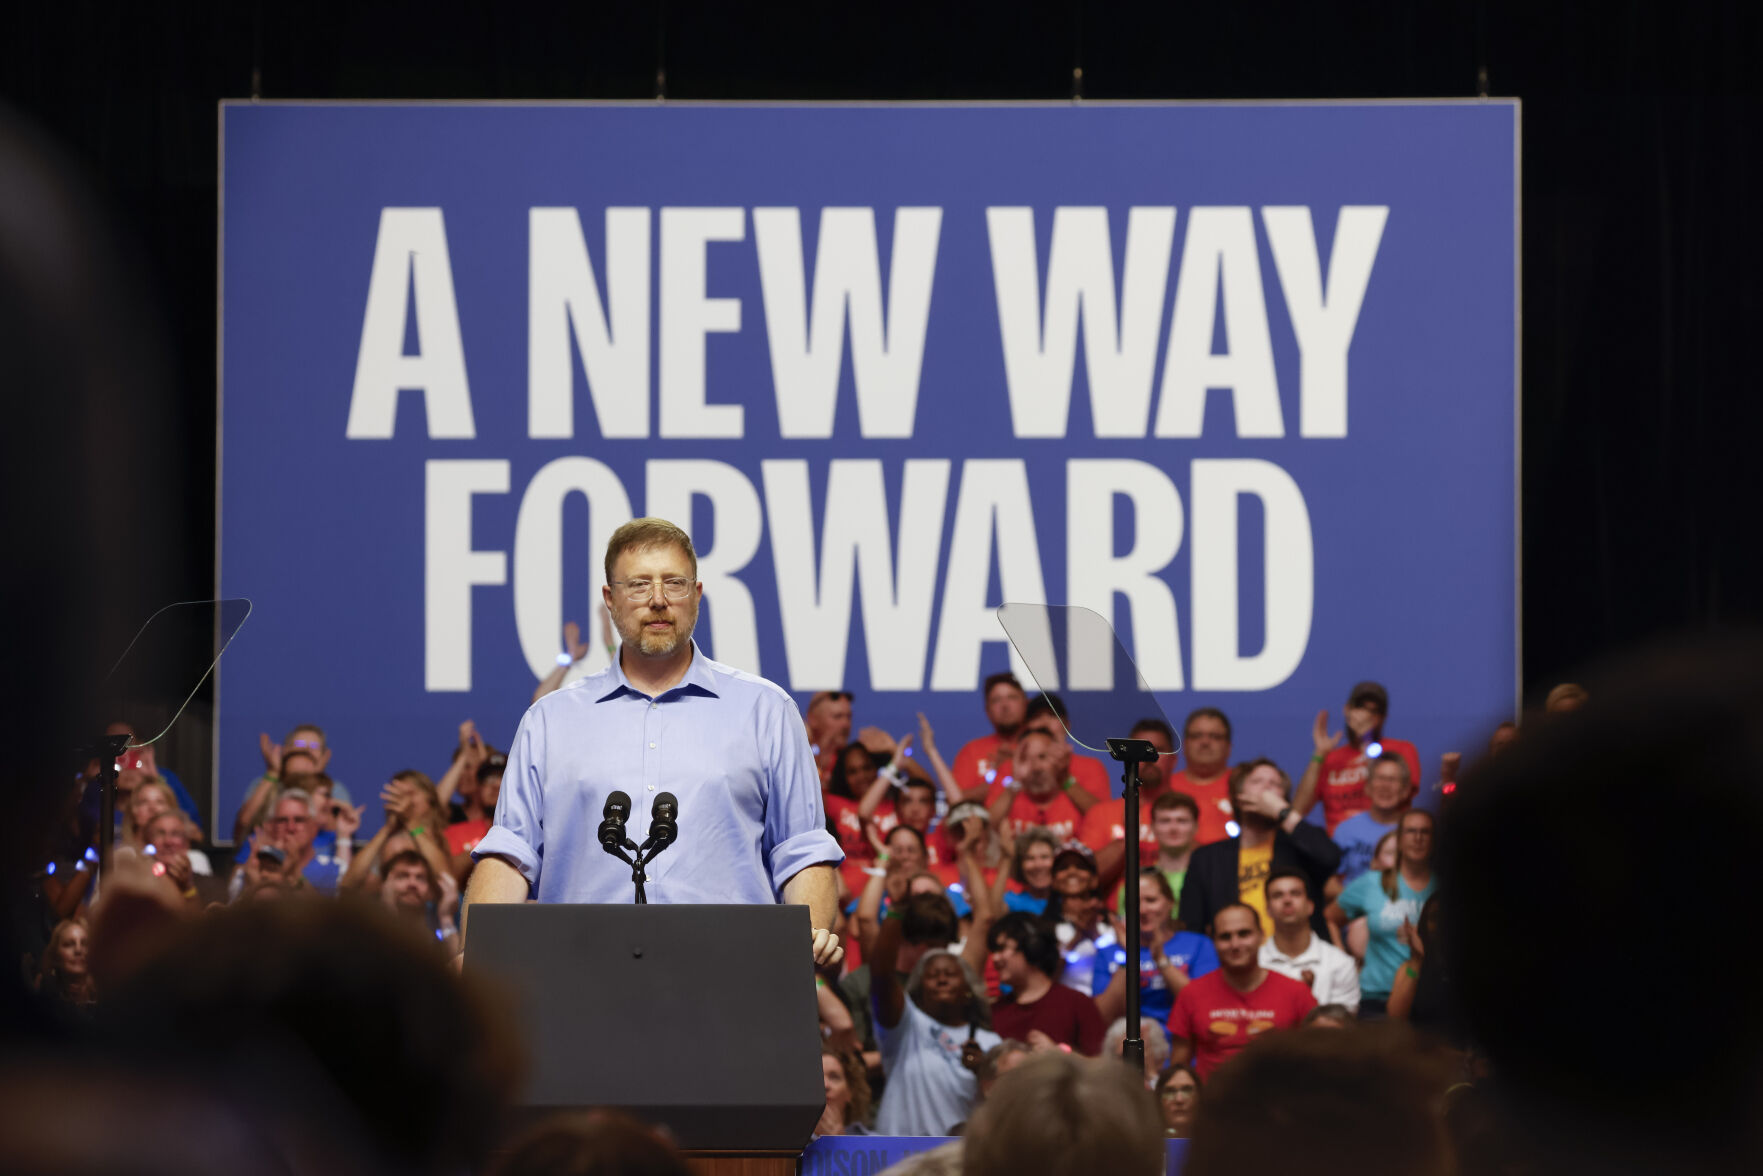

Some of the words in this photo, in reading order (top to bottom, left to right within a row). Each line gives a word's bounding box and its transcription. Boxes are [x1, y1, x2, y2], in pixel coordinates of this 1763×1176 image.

[346, 206, 476, 439] A
[527, 206, 943, 439] NEW
[986, 205, 1390, 439] WAY
[424, 456, 1315, 692] FORWARD
